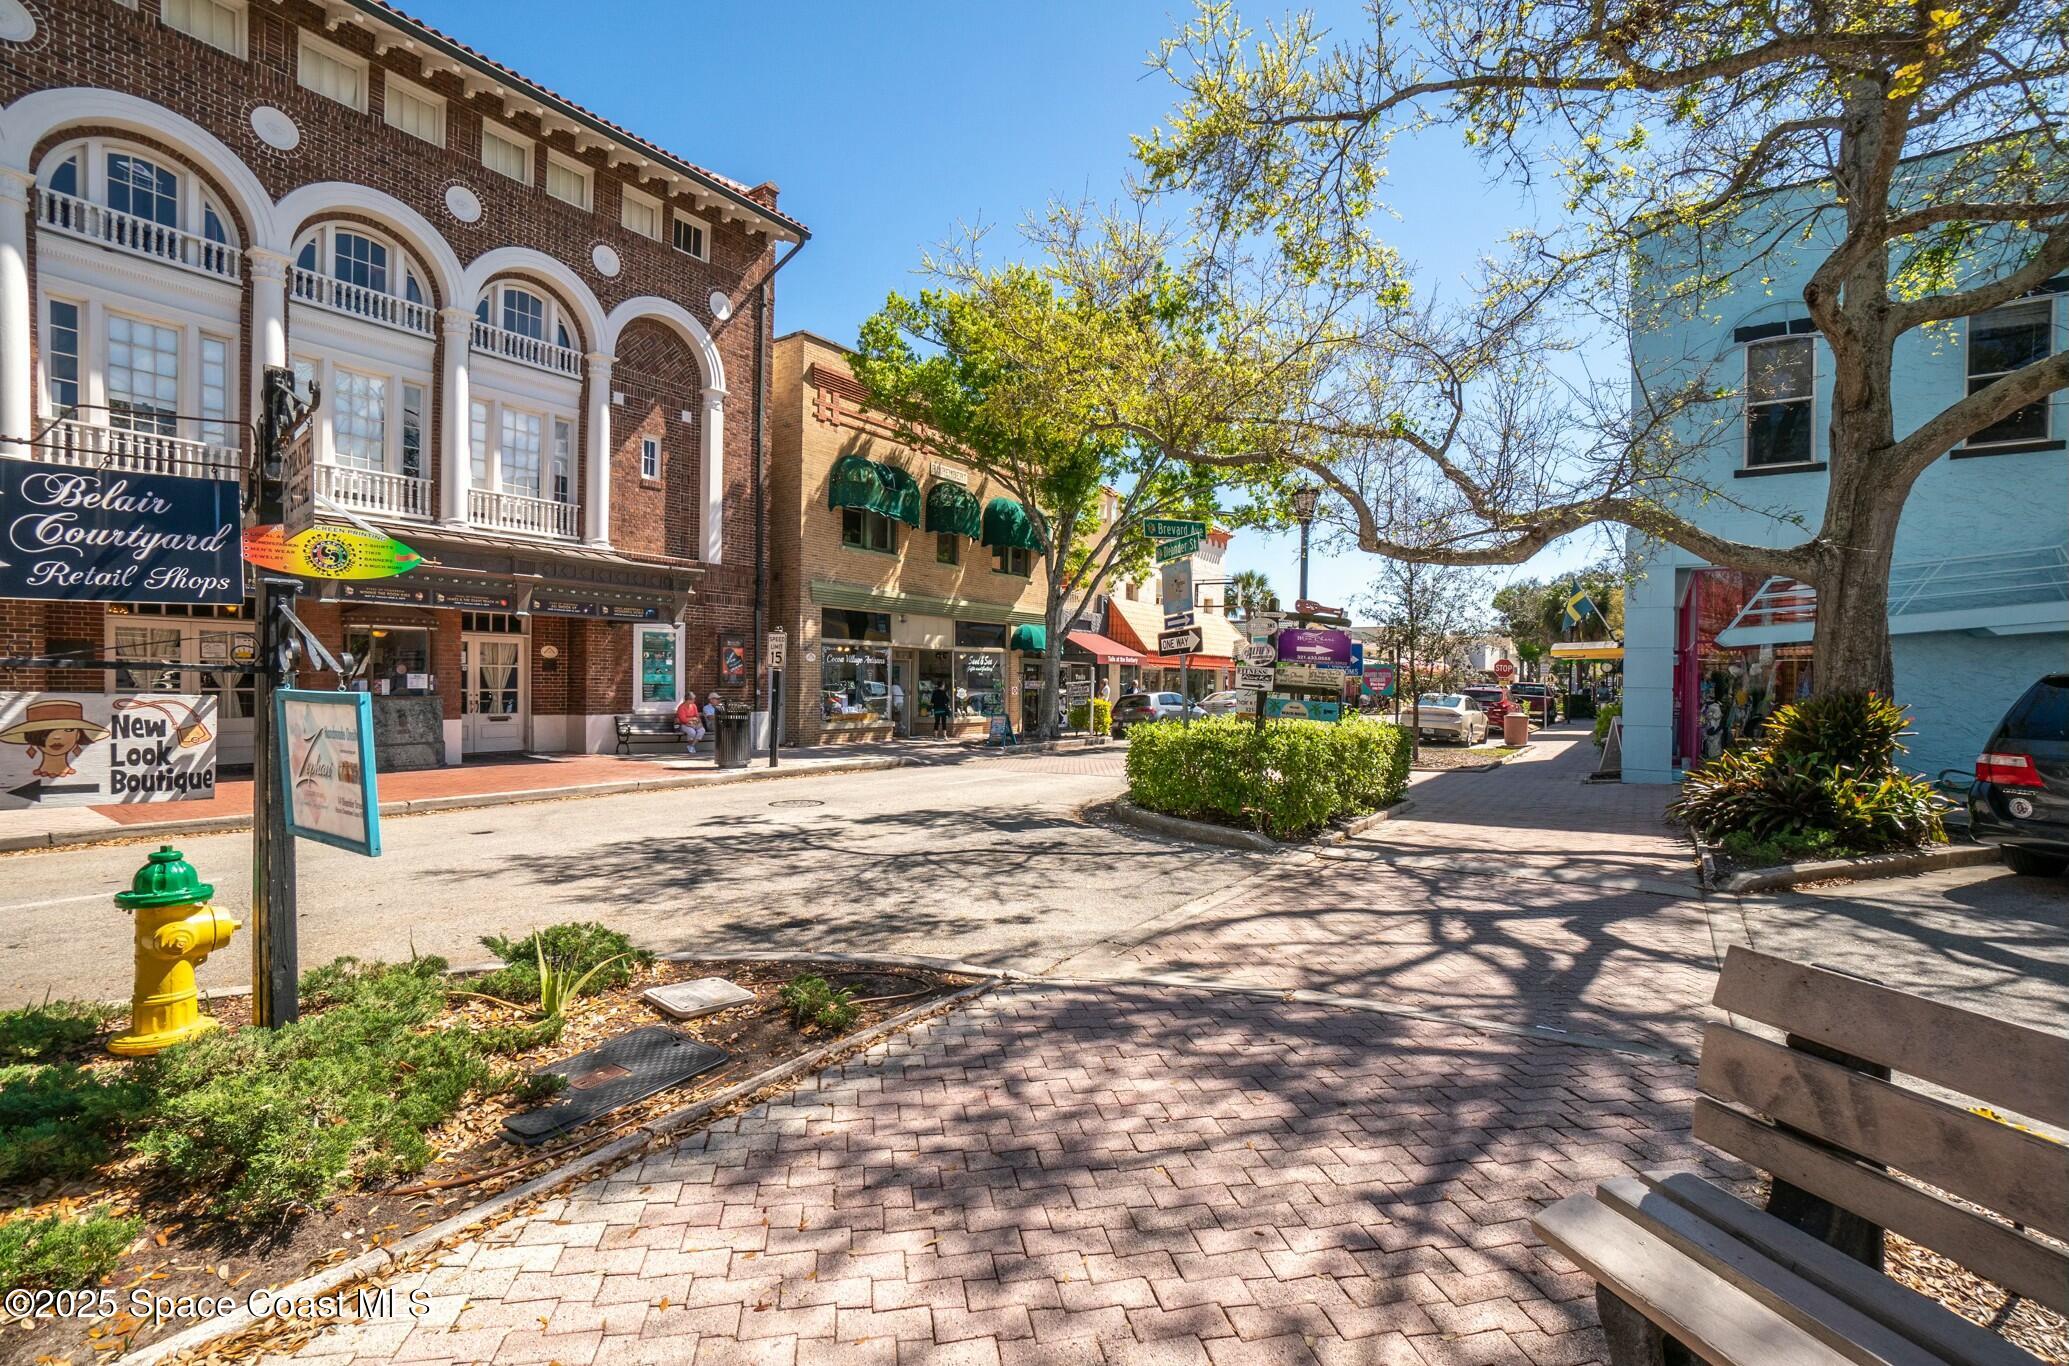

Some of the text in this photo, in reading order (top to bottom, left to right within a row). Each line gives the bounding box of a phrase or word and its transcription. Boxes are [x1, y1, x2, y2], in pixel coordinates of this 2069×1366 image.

[21, 473, 172, 514] Belair
[9, 512, 233, 560] Courtyard
[1157, 522, 1188, 536] Brevard
[1190, 537, 1197, 550] St
[26, 560, 138, 586] Retail
[144, 566, 230, 598] Shops
[1162, 636, 1189, 649] ONE WAY
[770, 651, 783, 663] 15
[826, 653, 886, 666] Cocoa Village Artisans
[1495, 664, 1513, 672] STOP
[111, 714, 166, 739] New
[110, 740, 173, 767] Look
[110, 768, 213, 795] Boutique
